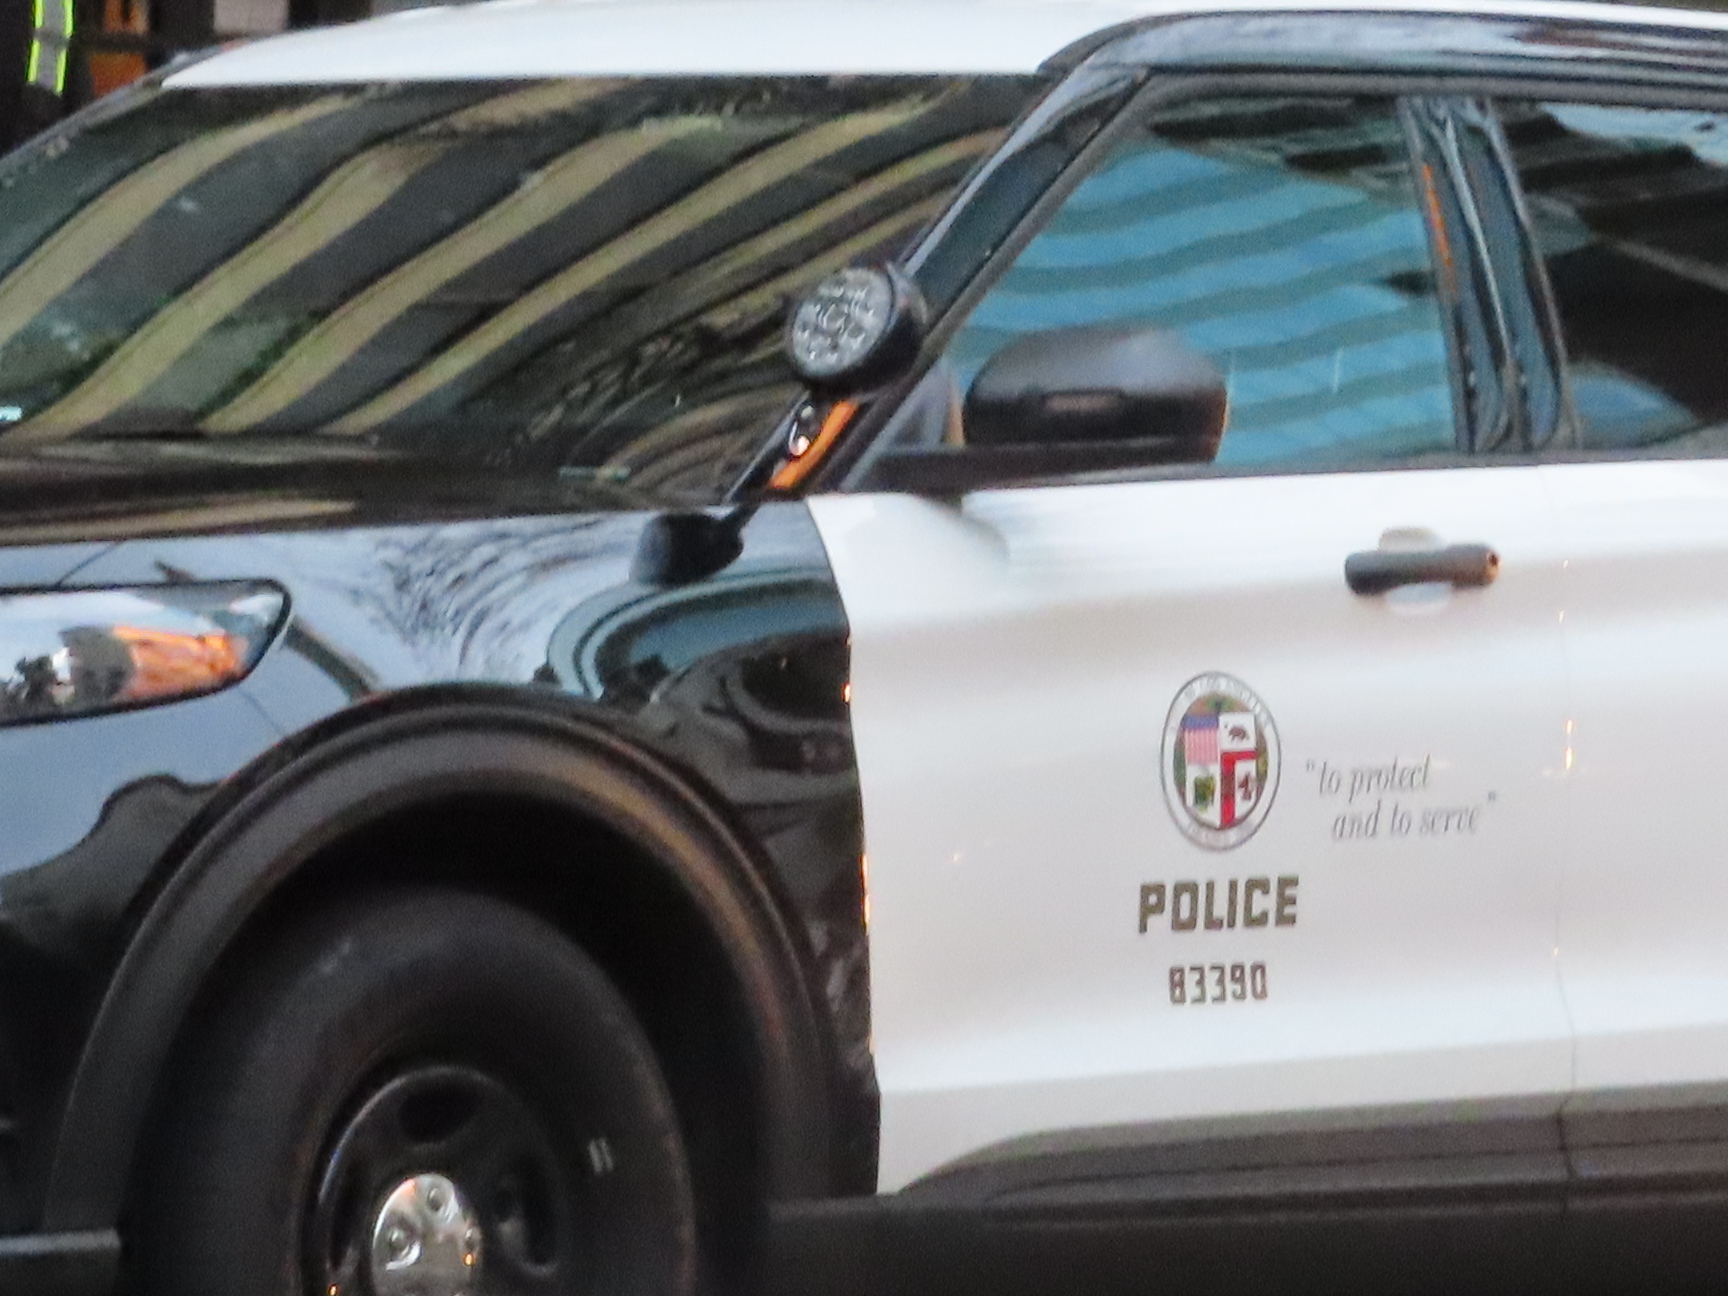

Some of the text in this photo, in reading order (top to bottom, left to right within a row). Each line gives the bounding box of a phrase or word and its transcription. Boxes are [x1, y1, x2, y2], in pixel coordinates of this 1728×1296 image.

[1346, 753, 1431, 804] protect
[1332, 797, 1382, 840] and
[1390, 802, 1412, 835] to
[1138, 875, 1300, 934] POLICE
[1168, 961, 1269, 1005] 83390
